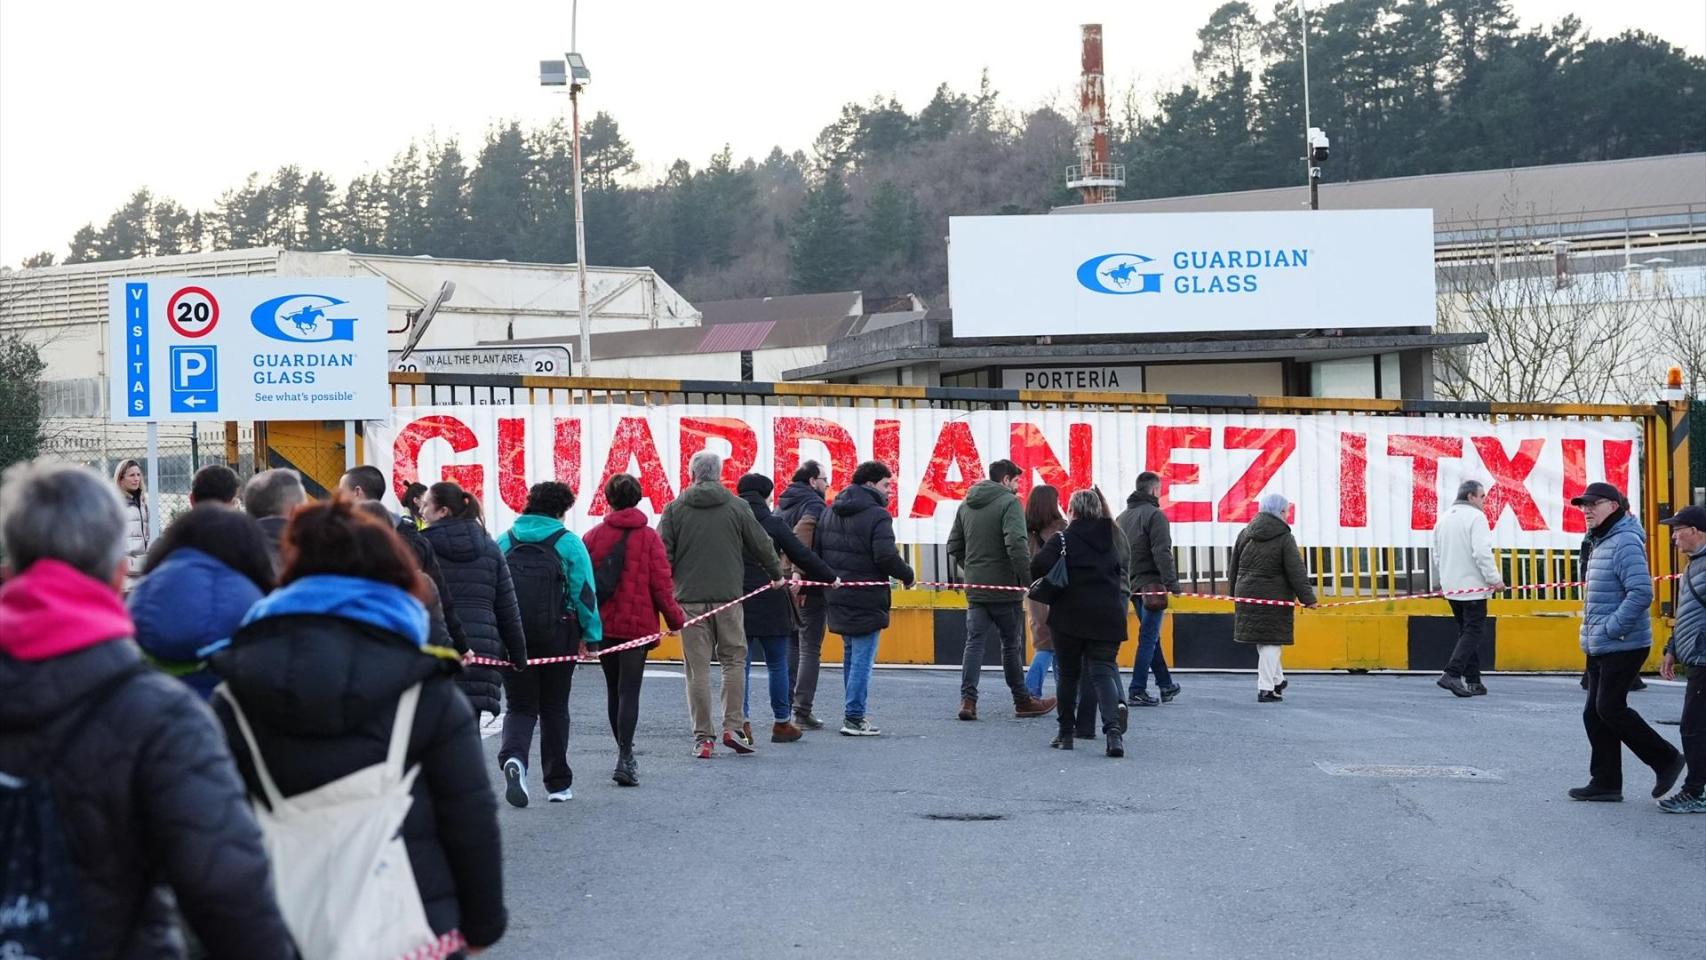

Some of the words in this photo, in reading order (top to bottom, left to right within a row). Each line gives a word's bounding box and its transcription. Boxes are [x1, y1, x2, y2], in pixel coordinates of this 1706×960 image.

[1173, 249, 1308, 269] GUARDIAN
[1174, 274, 1257, 293] GLASS
[177, 302, 210, 322] 20
[131, 288, 144, 411] VISITAS
[253, 354, 353, 367] GUARDIAN
[426, 355, 434, 366] IN
[437, 355, 452, 365] ALL
[454, 354, 470, 365] THE
[472, 354, 500, 364] PLANT
[501, 353, 525, 364] AREA
[535, 360, 554, 372] 20
[179, 352, 207, 388] P
[253, 371, 316, 384] GLASS
[1025, 368, 1119, 389] PORTERÍA
[255, 392, 273, 402] See
[276, 391, 309, 401] what's
[311, 391, 353, 403] possible
[392, 415, 1093, 518] GUARDIAN
[1145, 425, 1296, 524] EZ
